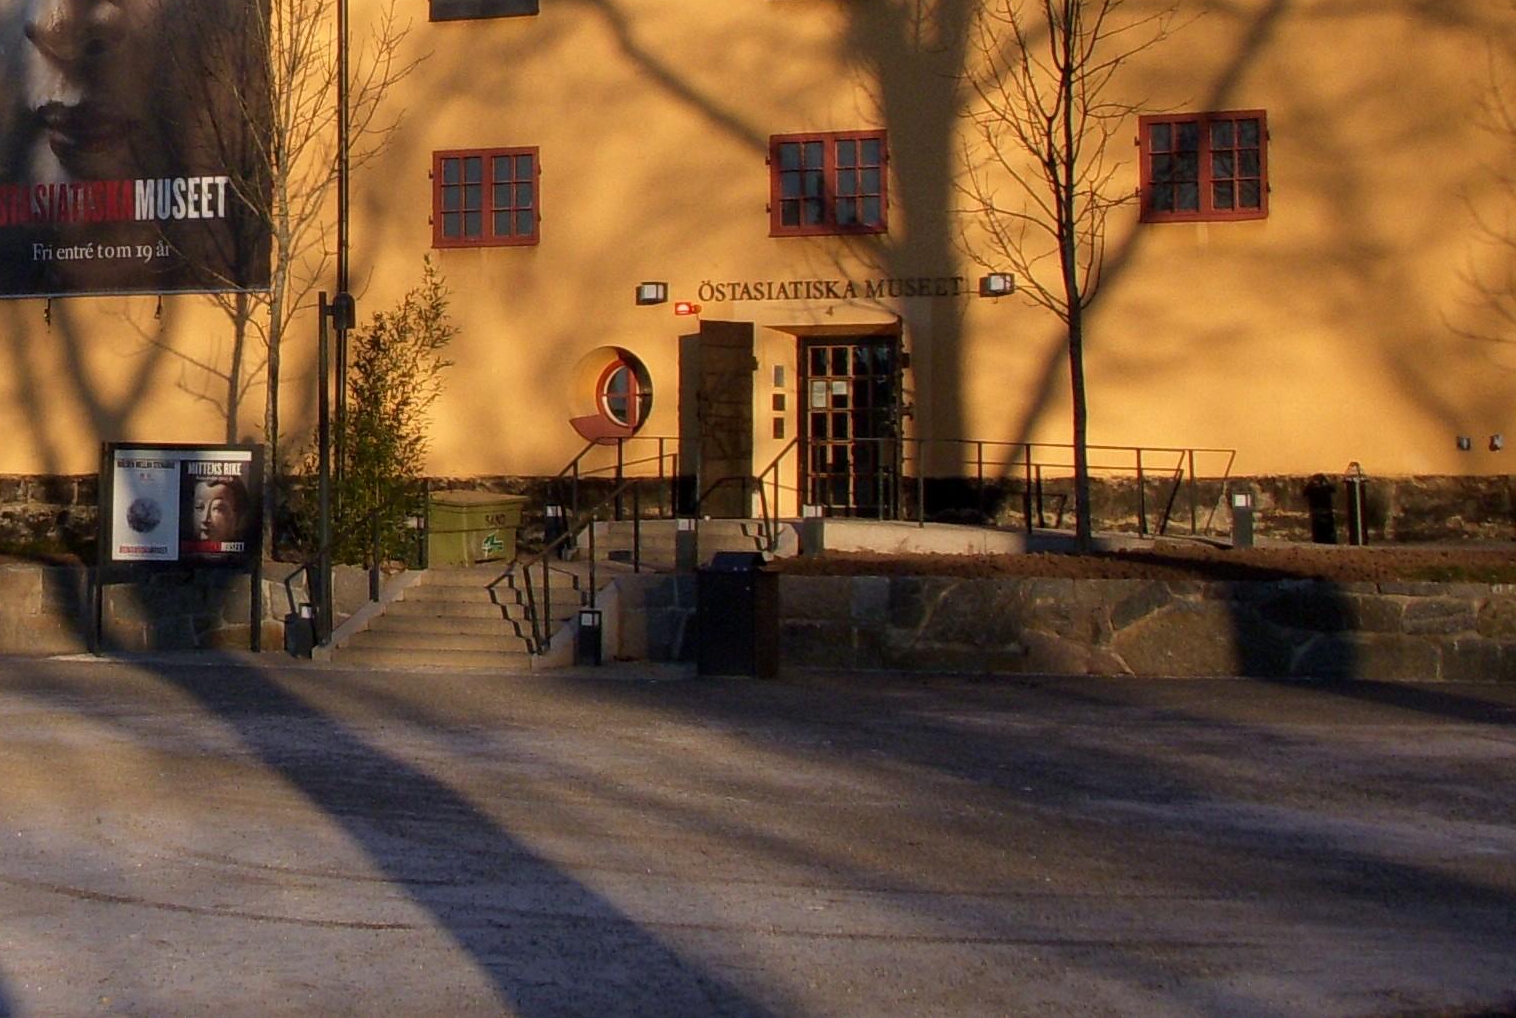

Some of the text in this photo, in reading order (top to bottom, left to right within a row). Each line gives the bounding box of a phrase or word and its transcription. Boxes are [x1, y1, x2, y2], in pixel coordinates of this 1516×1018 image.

[32, 243, 53, 260] Fri
[56, 243, 94, 260] entré
[135, 245, 153, 263] 19
[698, 276, 963, 302] ÖSTASIATISKA MUSEET
